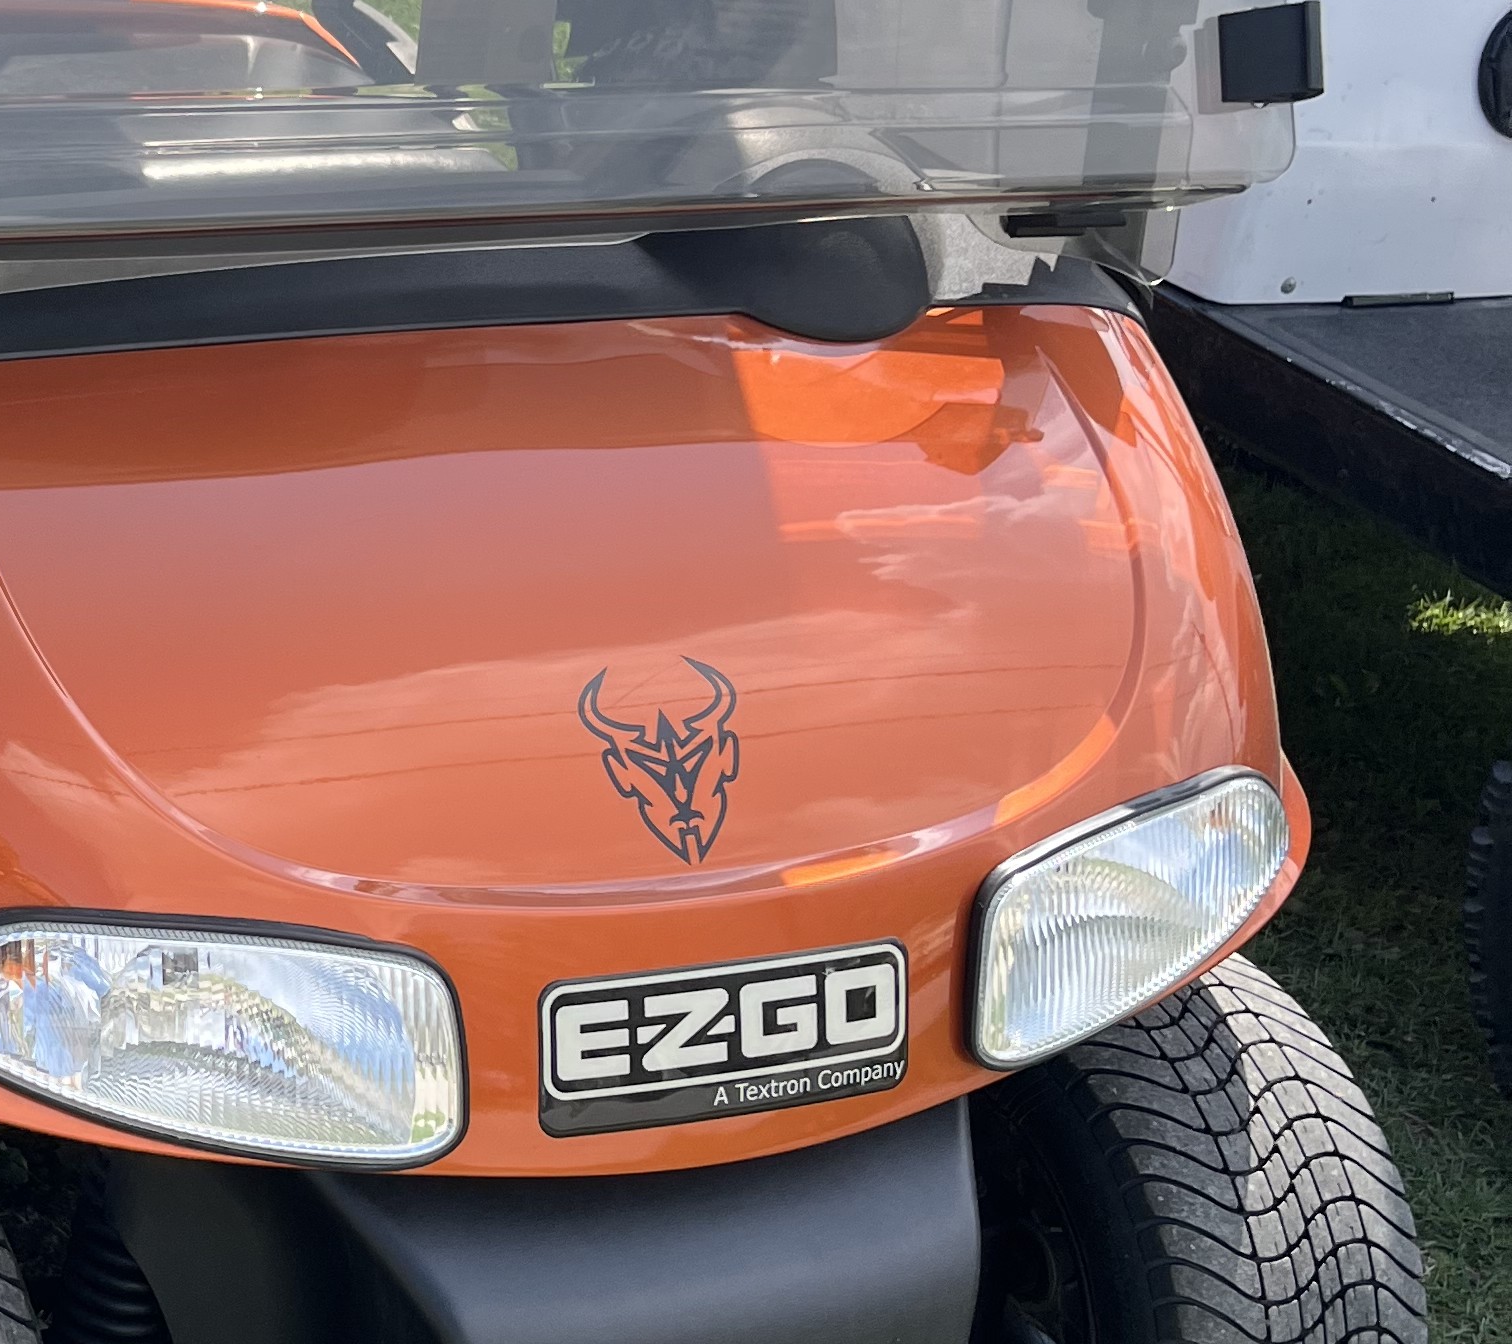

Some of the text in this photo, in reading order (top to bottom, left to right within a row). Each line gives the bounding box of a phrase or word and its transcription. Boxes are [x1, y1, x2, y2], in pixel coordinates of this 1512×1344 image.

[713, 1059, 906, 1107] A Textron Company
